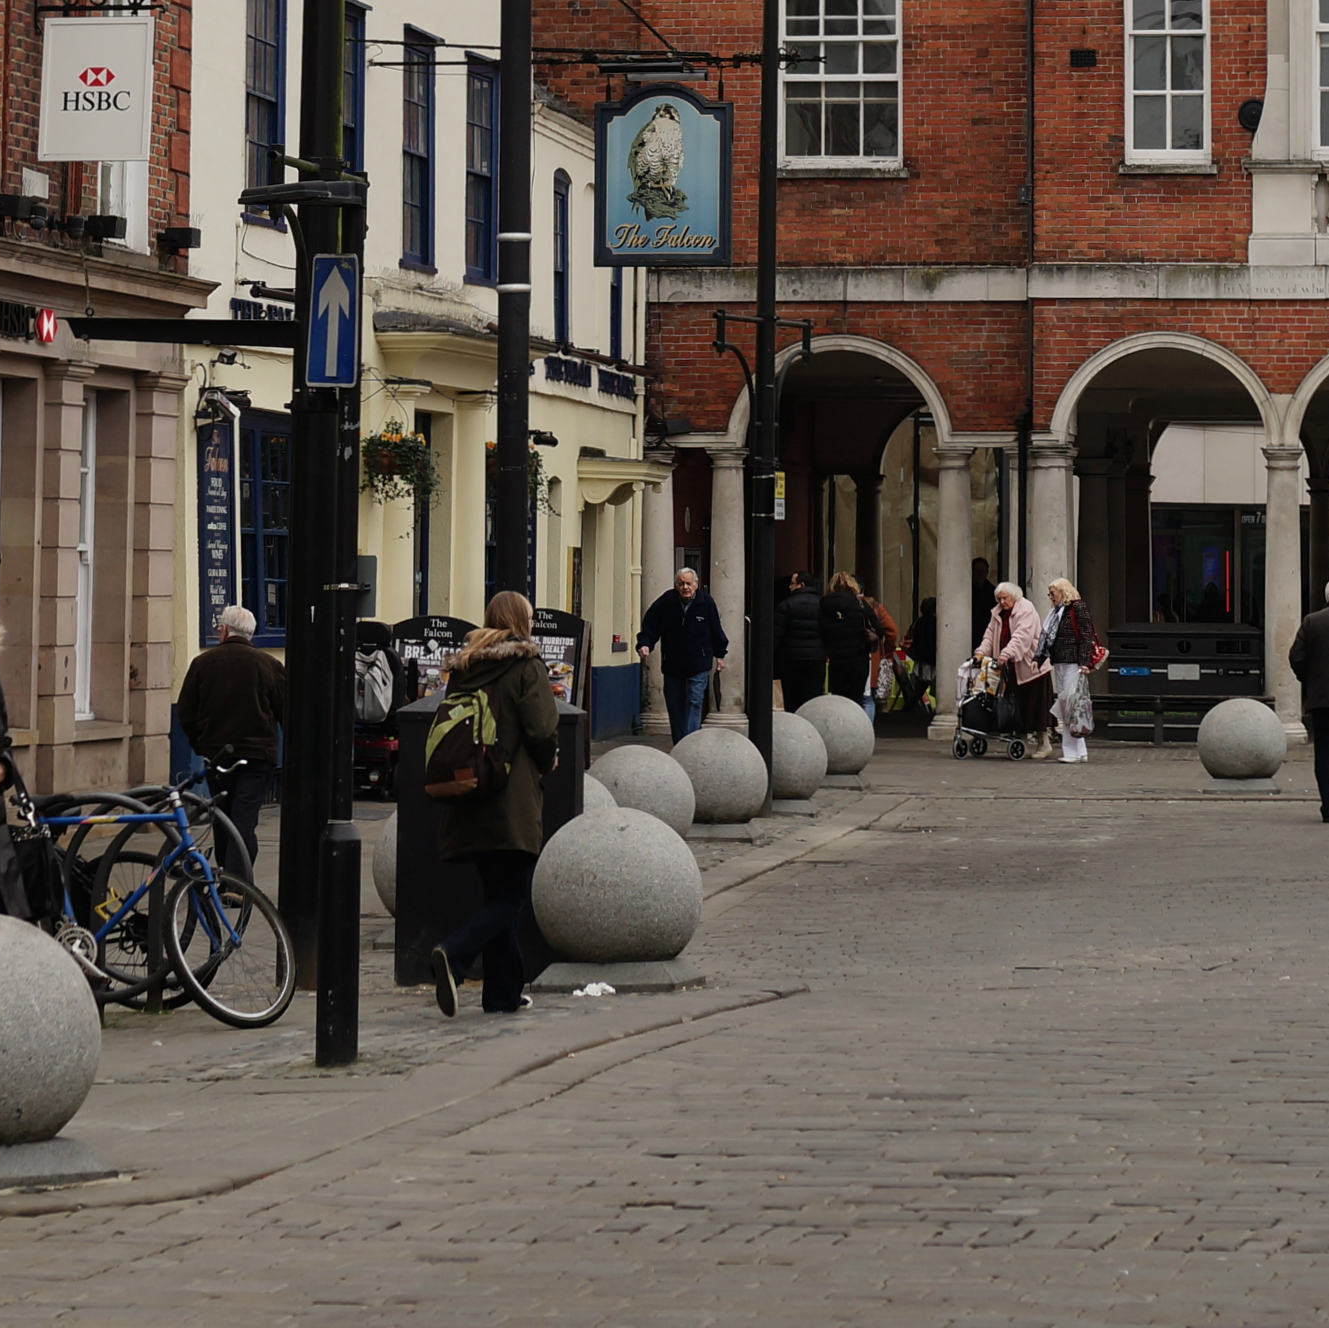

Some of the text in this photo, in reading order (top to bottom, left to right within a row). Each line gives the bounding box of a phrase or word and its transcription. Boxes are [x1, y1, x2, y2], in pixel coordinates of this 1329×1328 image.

[60, 90, 131, 111] HSBC
[608, 223, 716, 249] The Falcon
[536, 611, 553, 620] The
[430, 618, 448, 628] The
[424, 628, 453, 638] Falcon
[543, 637, 574, 646] BURRITOS
